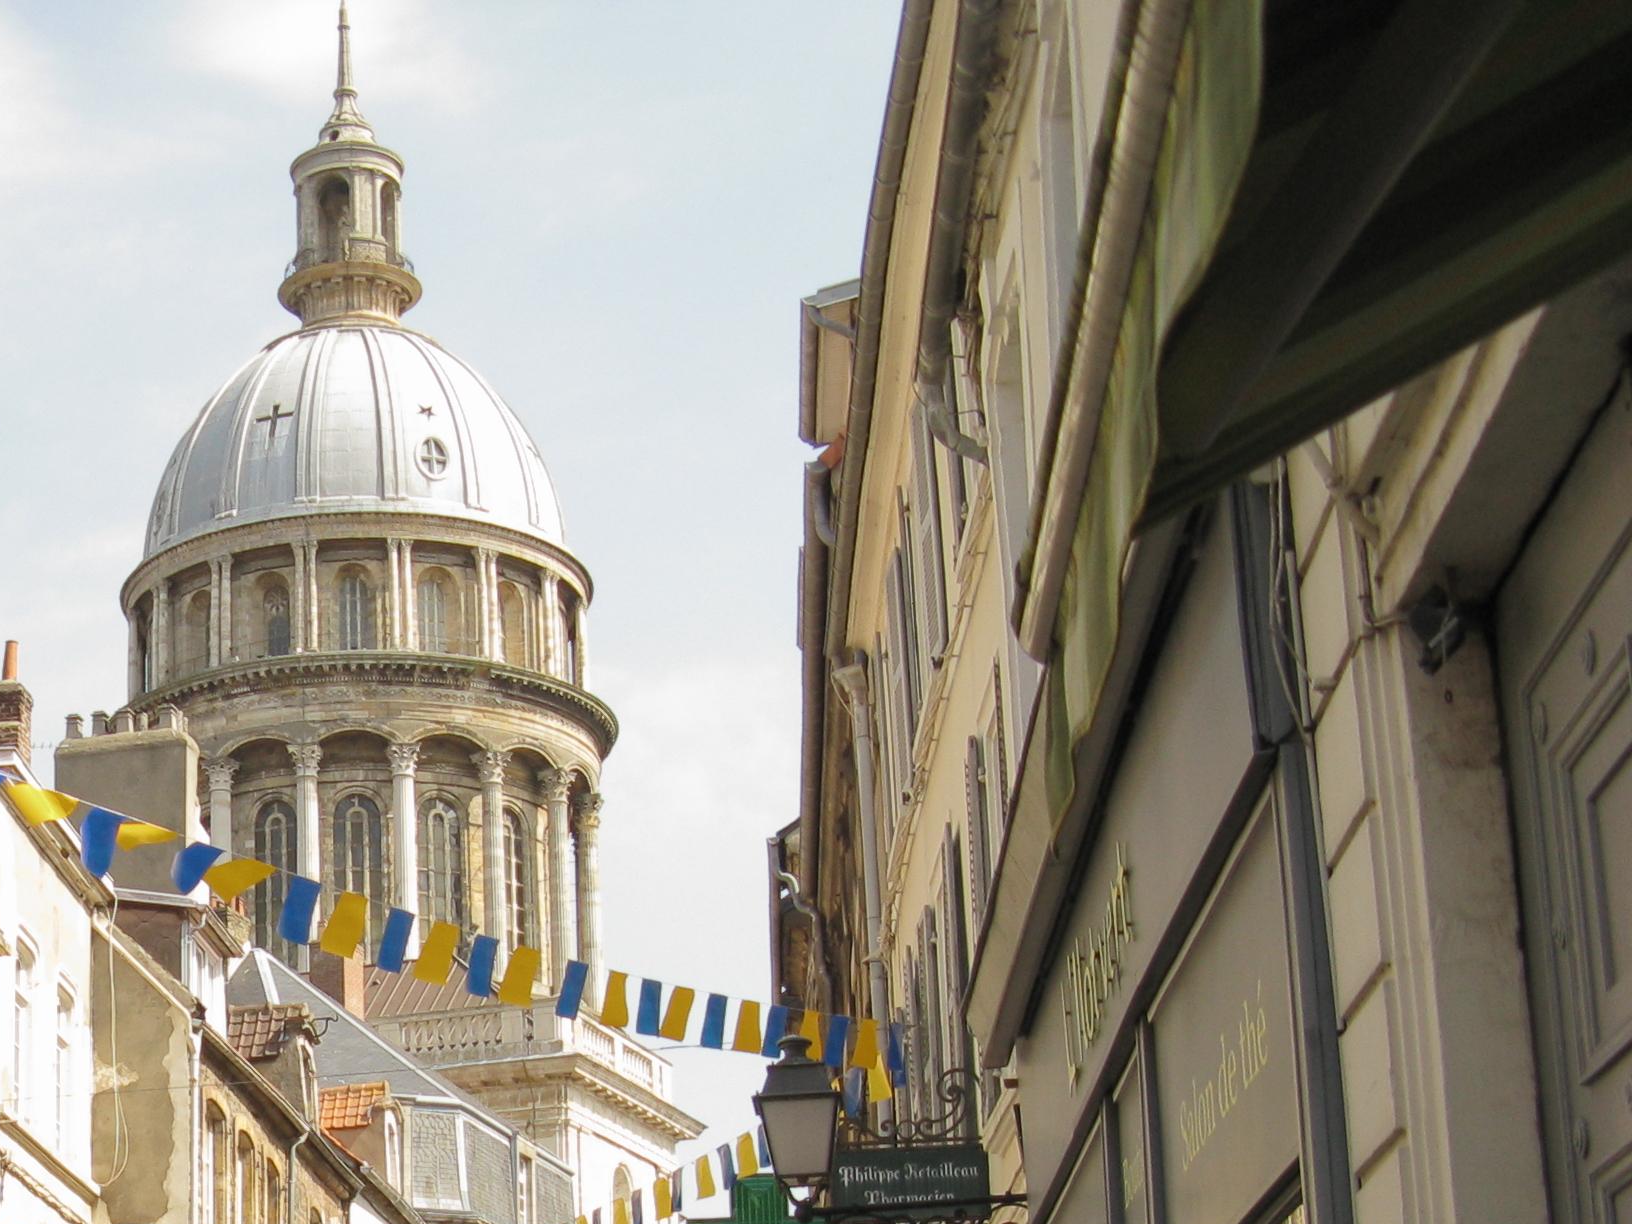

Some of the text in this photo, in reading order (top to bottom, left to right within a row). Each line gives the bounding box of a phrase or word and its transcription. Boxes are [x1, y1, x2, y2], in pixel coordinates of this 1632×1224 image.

[1098, 841, 1130, 1000] vert
[1180, 979, 1268, 1171] Salon de thé
[839, 1165, 901, 1187] Philippe
